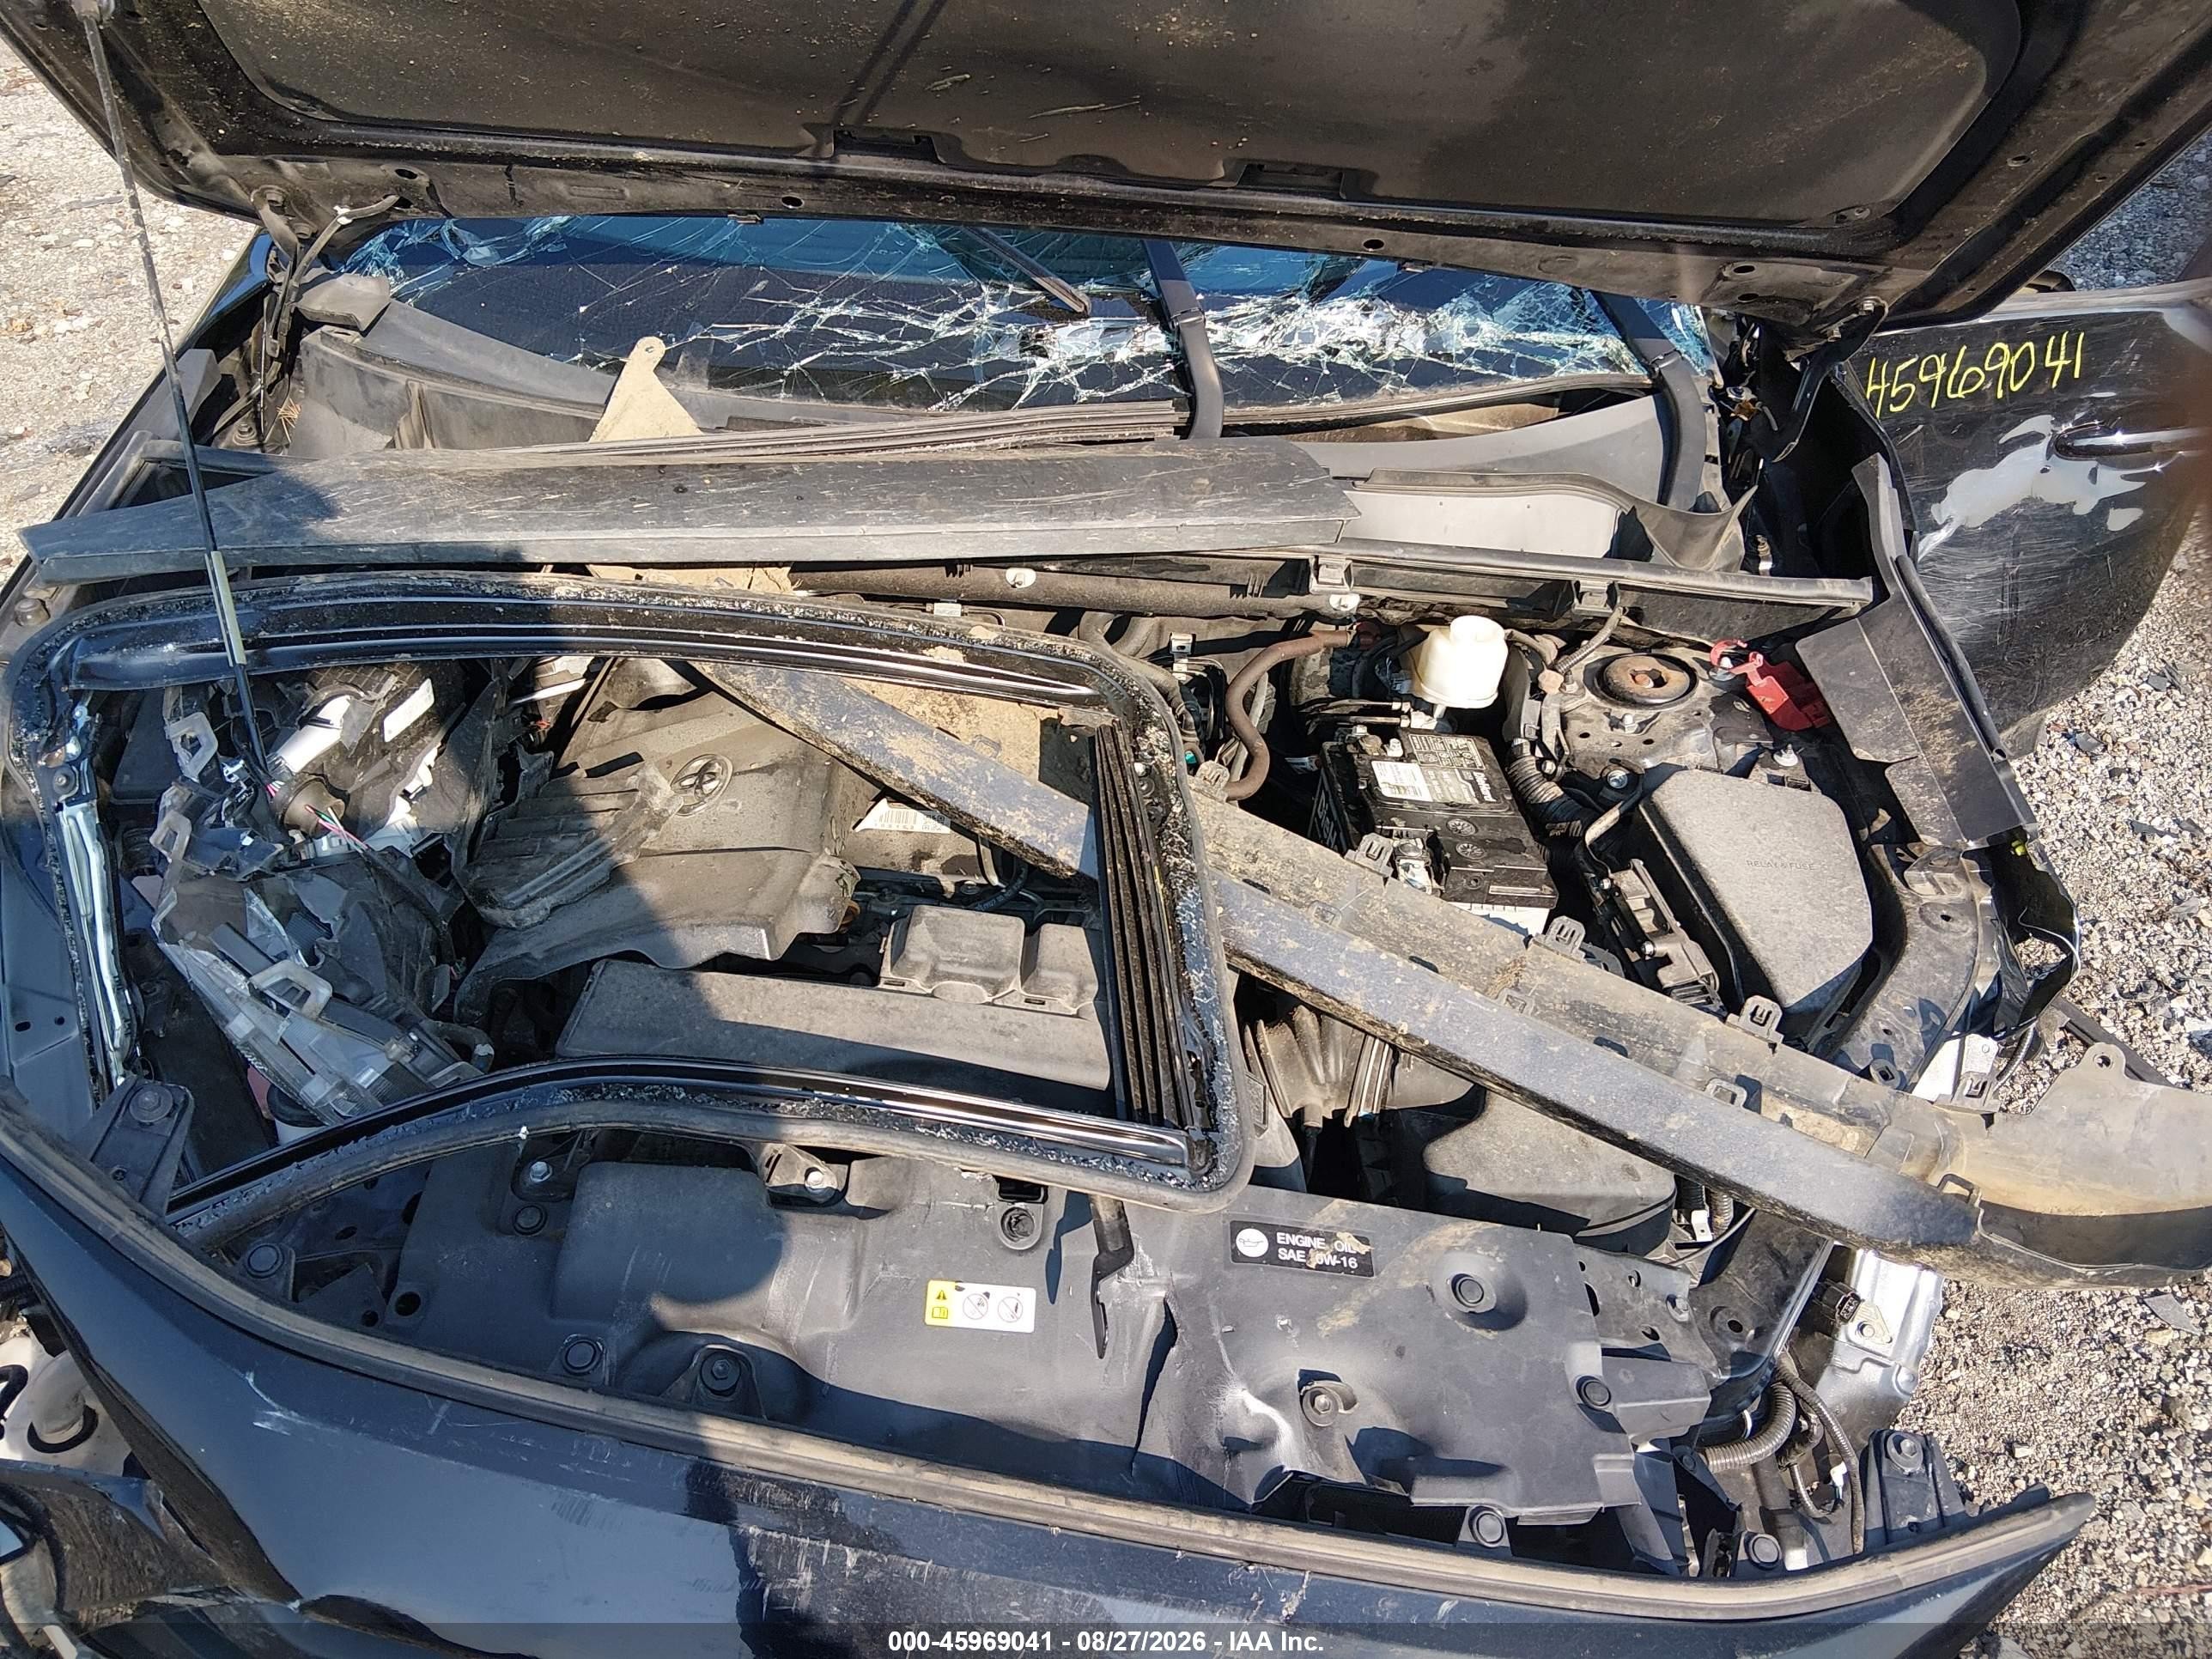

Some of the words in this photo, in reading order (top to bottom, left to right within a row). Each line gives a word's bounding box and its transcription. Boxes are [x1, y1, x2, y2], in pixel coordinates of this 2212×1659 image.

[1746, 860, 1778, 869] RELAY
[1789, 862, 1814, 871] FUSE
[1276, 1232, 1326, 1250] ENGINE
[1334, 1240, 1357, 1255] OIL
[1278, 1247, 1306, 1263] SAE
[1316, 1254, 1358, 1269] 0W-16
